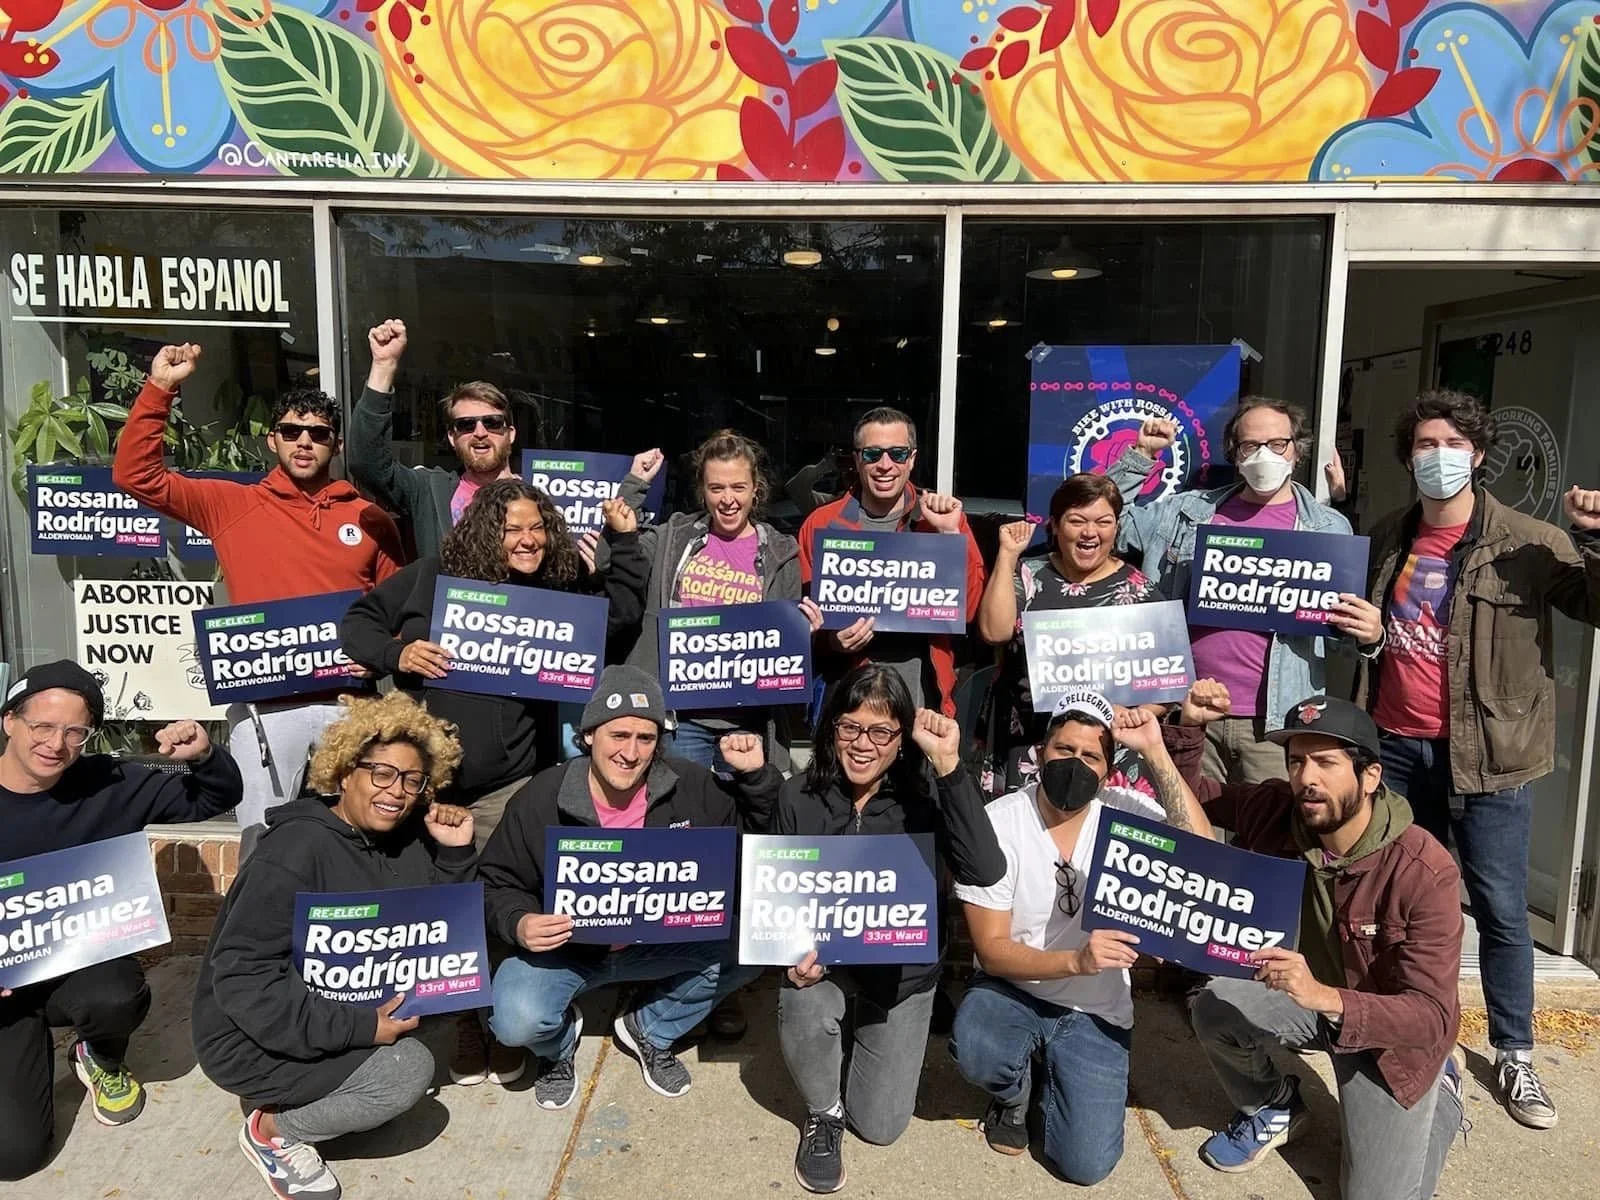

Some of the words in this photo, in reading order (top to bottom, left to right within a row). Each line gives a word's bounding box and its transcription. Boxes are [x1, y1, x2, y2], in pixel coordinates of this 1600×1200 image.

[11, 253, 46, 307] SE
[56, 254, 152, 309] HABLA
[161, 257, 289, 313] ESPANOL
[1071, 409, 1099, 436] BIKE
[1099, 398, 1134, 414] WITH
[1136, 399, 1185, 435] ROSSANA
[1541, 430, 1559, 499] FAMILIES
[532, 473, 622, 499] Rossan
[37, 486, 138, 510] Rossana
[37, 510, 160, 538] Rodríguez
[346, 527, 356, 537] R
[37, 532, 94, 541] ALDERWOMAN
[117, 535, 137, 543] 33rd
[137, 535, 158, 544] Ward
[825, 540, 868, 550] RE-ELECT
[1208, 534, 1257, 547] RE-ELECT
[684, 560, 756, 586] Rossana
[821, 552, 937, 579] Rossana
[1202, 549, 1333, 582] Rossana
[81, 583, 215, 606] ABORTION
[449, 590, 499, 604] RE-ELECT
[682, 576, 762, 605] Rodrígue
[818, 579, 960, 612] Rodríguez
[1198, 575, 1340, 613] Rodrígue
[819, 604, 881, 614] ALDERWOMAN
[910, 608, 930, 616] 33rd
[932, 608, 956, 617] Ward
[1197, 600, 1267, 614] ALDERWOMAN
[1299, 610, 1322, 621] 33rd
[83, 614, 182, 636] JUSTICE
[208, 614, 258, 628] RE-ELECT
[443, 602, 574, 642] Rossana
[670, 617, 713, 627] RE-ELECT
[208, 621, 337, 656] Rossana
[669, 629, 780, 655] Rossana
[1035, 631, 1156, 657] Rossana
[86, 644, 154, 665] NOW
[212, 647, 350, 681] Rodrígue
[439, 633, 597, 675] Rodríguez
[317, 668, 339, 677] 33rd
[450, 661, 511, 676] DERWOMAN
[541, 671, 565, 682] 33rd
[566, 673, 591, 685] Ward
[668, 653, 804, 685] Rodríguez
[1037, 655, 1186, 686] Rodríguez
[215, 674, 286, 690] ALDERWOMAN
[669, 681, 733, 692] ALDERWOMAN
[758, 678, 779, 688] 33rd
[780, 677, 801, 686] Ward
[1135, 679, 1158, 687] 33rd
[1159, 677, 1185, 686] Ward
[561, 840, 614, 851] RE-ELECT
[1112, 823, 1167, 849] RE-ELECT
[758, 850, 811, 859] RE-ELECT
[556, 855, 698, 884] Rossana
[753, 865, 897, 894] Rossana
[1103, 839, 1255, 914] Rossana
[312, 906, 371, 918] RE-ELECT
[554, 887, 726, 921] Rodríguez
[1094, 872, 1285, 951] Rodríguez
[569, 917, 632, 928] DERWOMAN
[667, 915, 692, 924] 33rd
[693, 913, 720, 923] Ward
[751, 898, 927, 937] Rodríguez
[1092, 903, 1175, 939] ALDERWOMAN
[305, 919, 448, 954] Rossana
[866, 931, 892, 941] 33rd
[894, 930, 923, 941] Ward
[1210, 944, 1241, 961] 33rd
[303, 951, 479, 992] Rodríguez
[418, 982, 445, 994] 33rd
[448, 979, 477, 989] Ward
